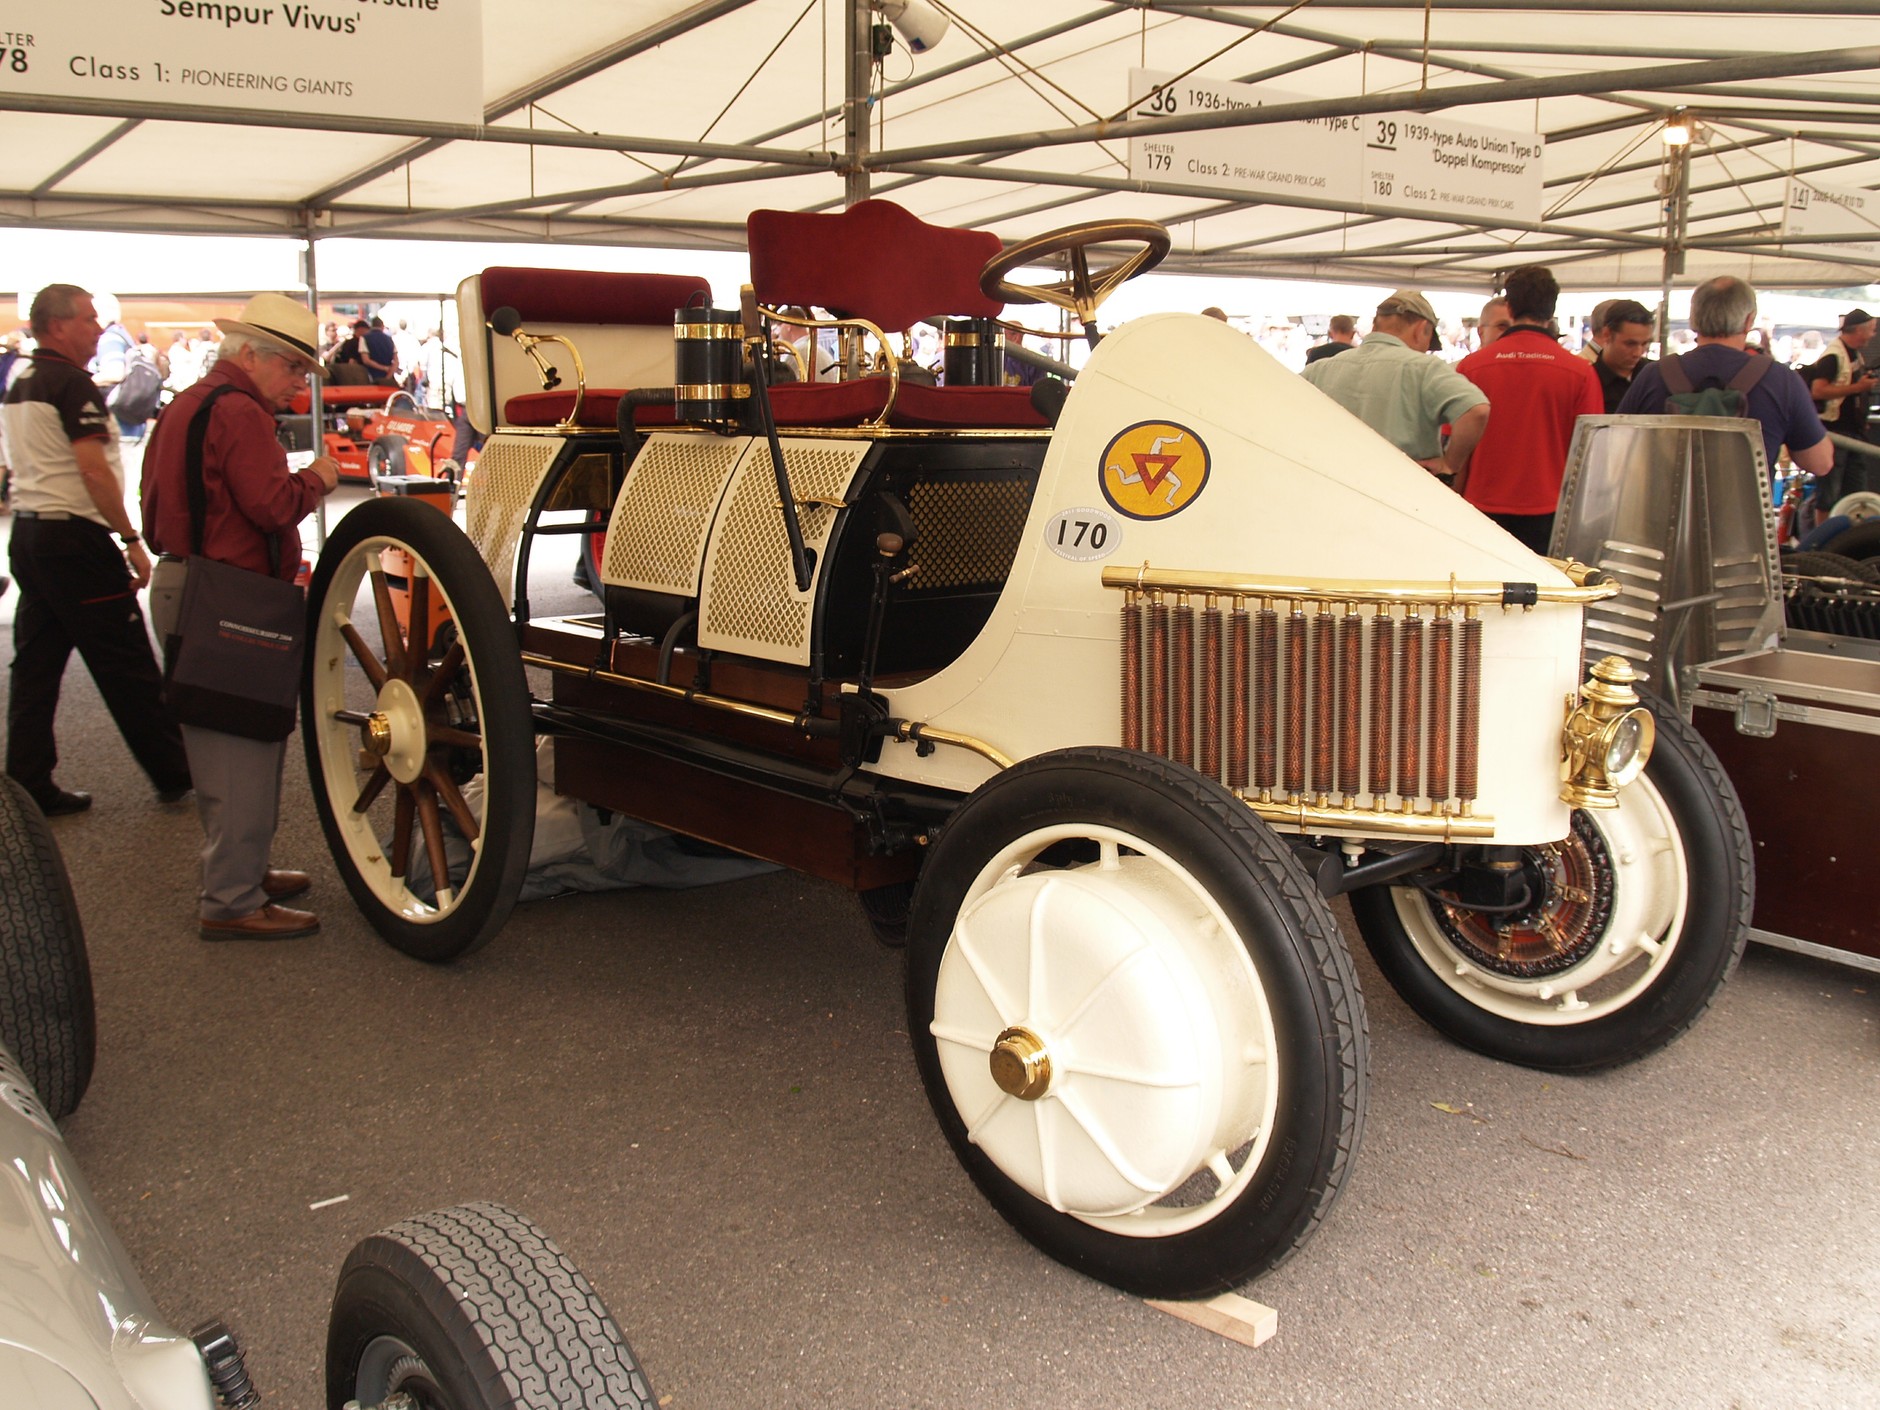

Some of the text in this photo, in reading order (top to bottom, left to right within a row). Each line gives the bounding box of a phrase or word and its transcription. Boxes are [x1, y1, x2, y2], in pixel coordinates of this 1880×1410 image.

[161, 0, 360, 34] Sempur Vivus'
[69, 56, 354, 97] Class 1: PIONEERING GIANTS
[1151, 84, 1177, 113] 36
[1352, 115, 1360, 131] C
[1144, 142, 1175, 154] SHELTER
[1377, 119, 1542, 160] 39 1939-type Auto Union Type D
[1147, 153, 1172, 171] 179
[1187, 159, 1218, 176] Class
[1267, 171, 1293, 184] GRAND
[1309, 176, 1327, 188] CARS
[1373, 180, 1393, 196] 180
[1403, 184, 1428, 200] Class
[1076, 507, 1112, 521] GOODWOOD
[1057, 519, 1107, 549] 170
[1053, 547, 1078, 561] FESTIVAL
[1088, 552, 1106, 561] SPEED
